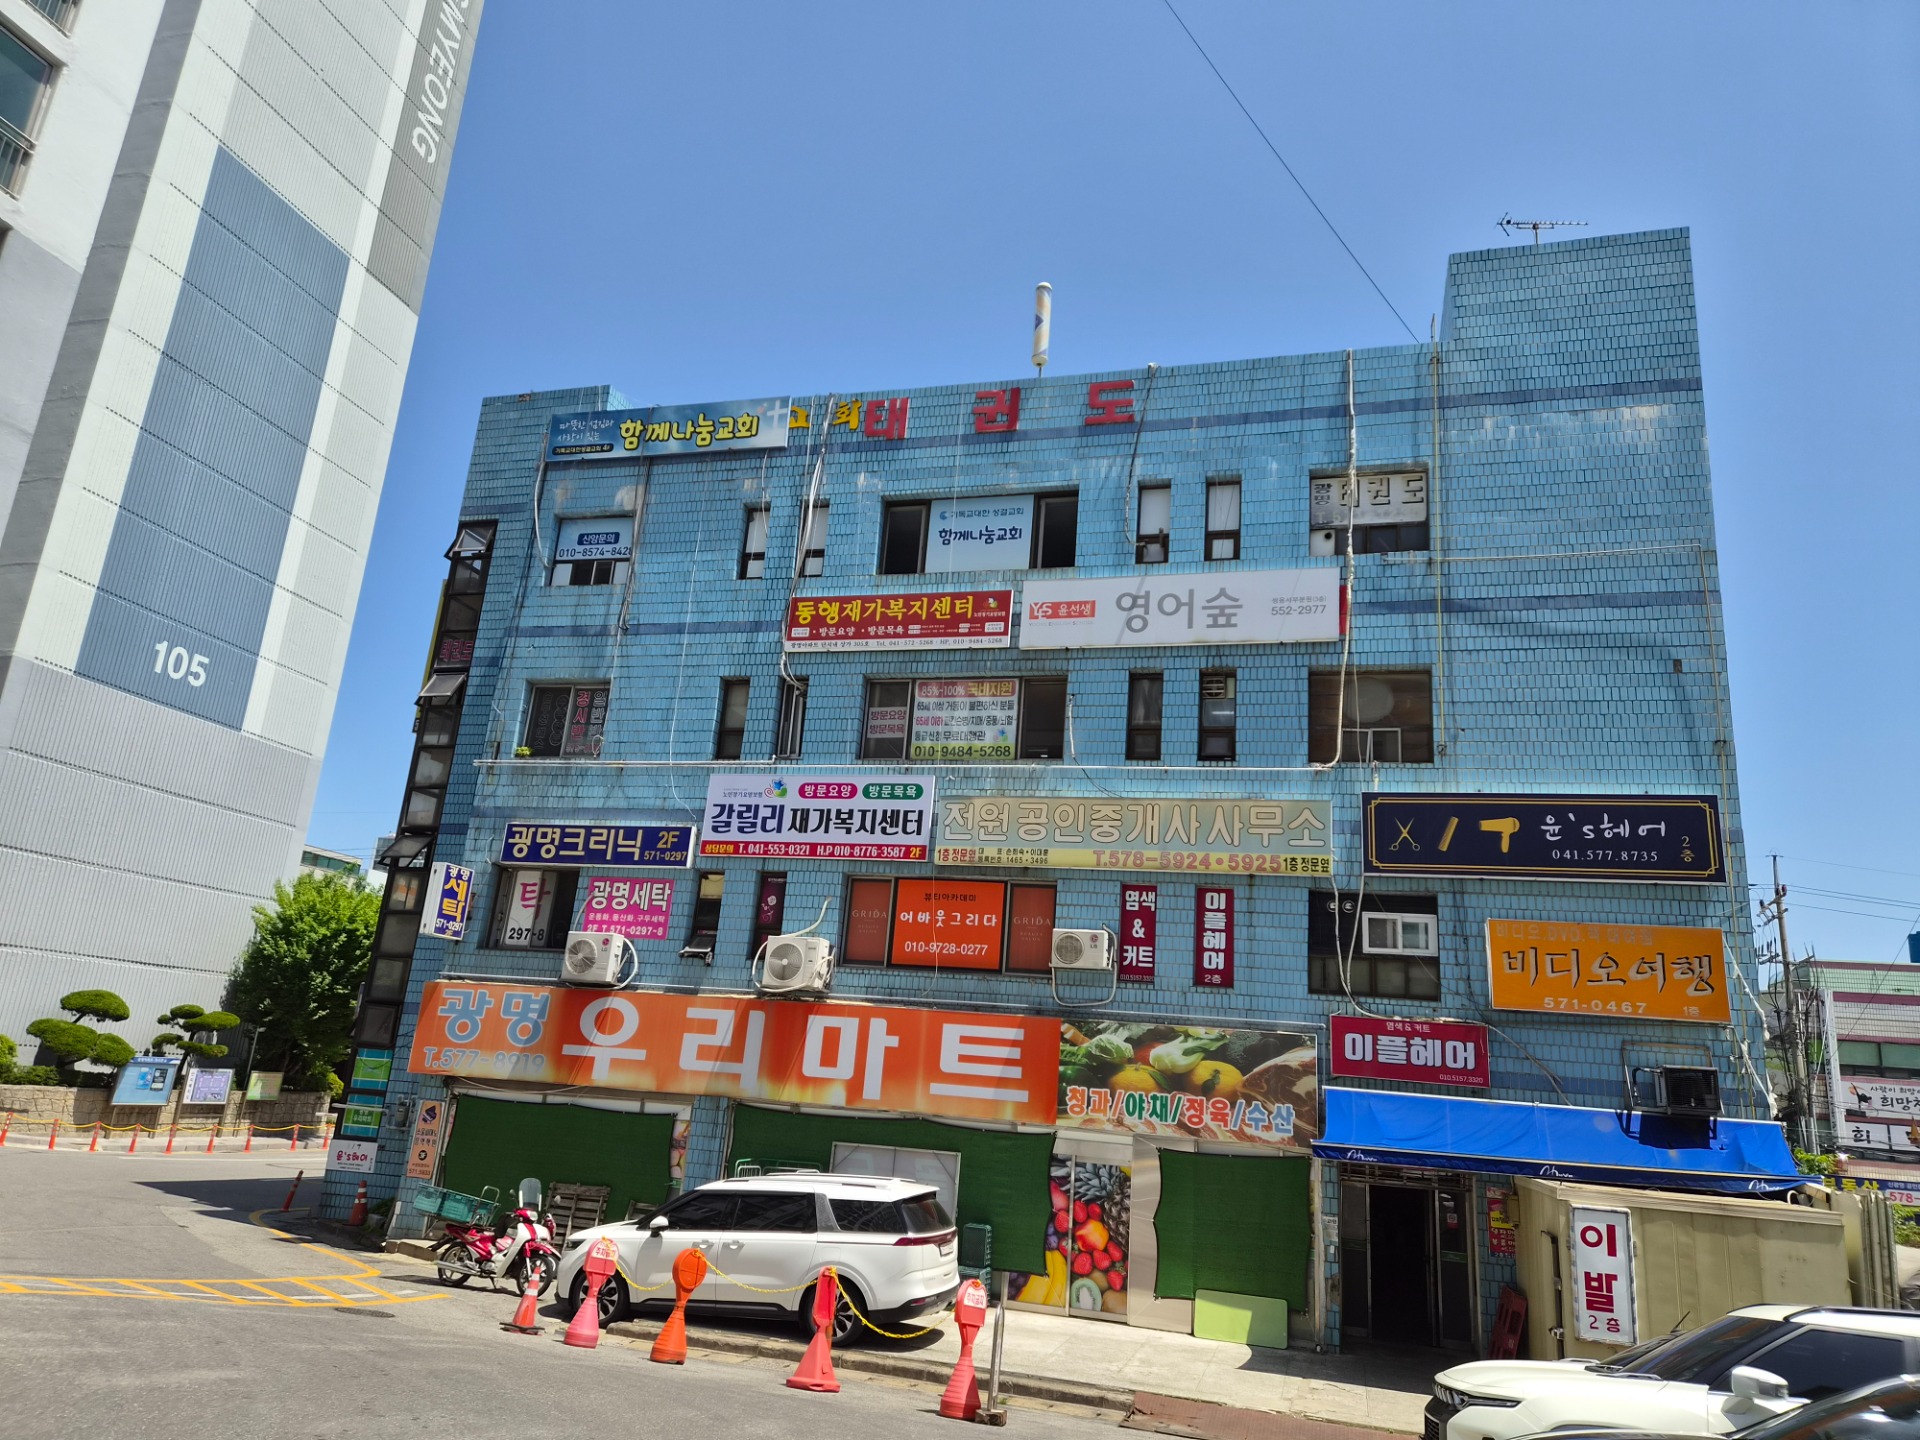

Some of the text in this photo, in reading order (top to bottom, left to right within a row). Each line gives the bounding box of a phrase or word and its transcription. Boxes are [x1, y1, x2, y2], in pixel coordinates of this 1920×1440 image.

[411, 0, 470, 164] MYEONG
[620, 414, 758, 450] 함께나눔교회
[582, 533, 616, 545] 신앙문의
[938, 525, 1023, 546] 함께나눔교회
[795, 596, 974, 624] 동행재가복지센터
[1057, 603, 1092, 616] 윤선생
[1116, 586, 1244, 633] 영어숲
[1271, 604, 1327, 616] 552-2977
[819, 626, 856, 637] 방문요양
[867, 625, 905, 636] 방문목욕
[154, 640, 210, 687] 105
[967, 681, 1013, 697] 국비지원
[870, 710, 907, 721] 방문요양
[869, 723, 905, 735] 방문목욕
[914, 745, 1012, 758] 010-9484-5268
[803, 785, 918, 799] 방문요양 방문목욕
[710, 803, 925, 837] 갈릴리 재가복지센터
[507, 826, 680, 861] 광명크리닉 2F
[748, 843, 810, 857] 041-553-0321
[833, 846, 906, 858] 010-8776-3587
[909, 847, 923, 859] 2F
[644, 849, 688, 862] 571-0297
[1552, 848, 1659, 862] 041.577.8735
[447, 865, 470, 880] 광명
[441, 878, 469, 923] 세탁
[591, 881, 671, 911] 광명세탁
[924, 892, 977, 902] 뷰티아카데미
[1125, 890, 1156, 912] 염색
[435, 918, 463, 932] 571-0297
[900, 909, 998, 928] 어바웃그리다
[1132, 918, 1146, 938] &
[1203, 891, 1227, 970] 이플헤어
[904, 940, 989, 956] 010-9728-0277
[1123, 945, 1154, 968] 커트
[1204, 974, 1222, 984] 2층
[1501, 946, 1716, 997] 비디오여행
[1543, 997, 1648, 1014] 571-0467
[438, 987, 549, 1047] 광명
[1386, 1021, 1404, 1032] 염색
[1414, 1024, 1432, 1033] 커트
[561, 996, 1033, 1103] 우리마트
[1344, 1032, 1477, 1071] 이플헤어
[1439, 1073, 1485, 1084] 010.5157.3320
[1579, 1223, 1619, 1314] 이발
[1588, 1314, 1621, 1333] 2층
